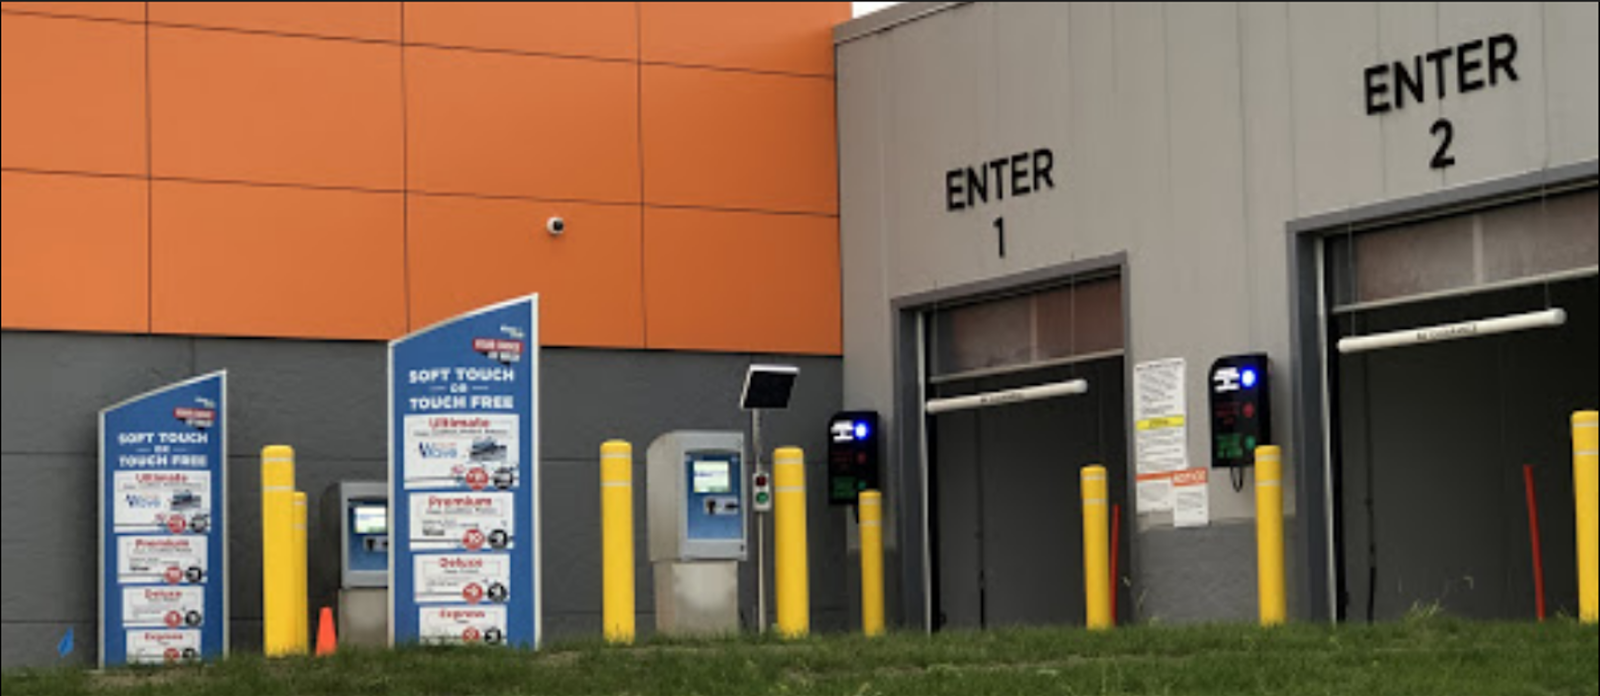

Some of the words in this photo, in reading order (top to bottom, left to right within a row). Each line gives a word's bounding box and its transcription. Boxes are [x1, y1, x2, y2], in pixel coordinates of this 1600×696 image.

[1364, 32, 1519, 115] ENTER
[1429, 118, 1455, 169] 2
[945, 147, 1054, 212] ENTER
[992, 216, 1005, 259] 1
[408, 367, 450, 384] SOFT
[455, 366, 515, 382] TOUCH
[408, 396, 467, 411] TOUCH
[471, 395, 515, 409] FREE
[428, 417, 490, 429] Ultimate
[118, 432, 155, 445] SOFT
[158, 432, 209, 444] TOUCH
[119, 454, 168, 468] TOUCH
[171, 454, 208, 468] FREE
[428, 496, 492, 509] Premium
[439, 557, 483, 569] Deluxe
